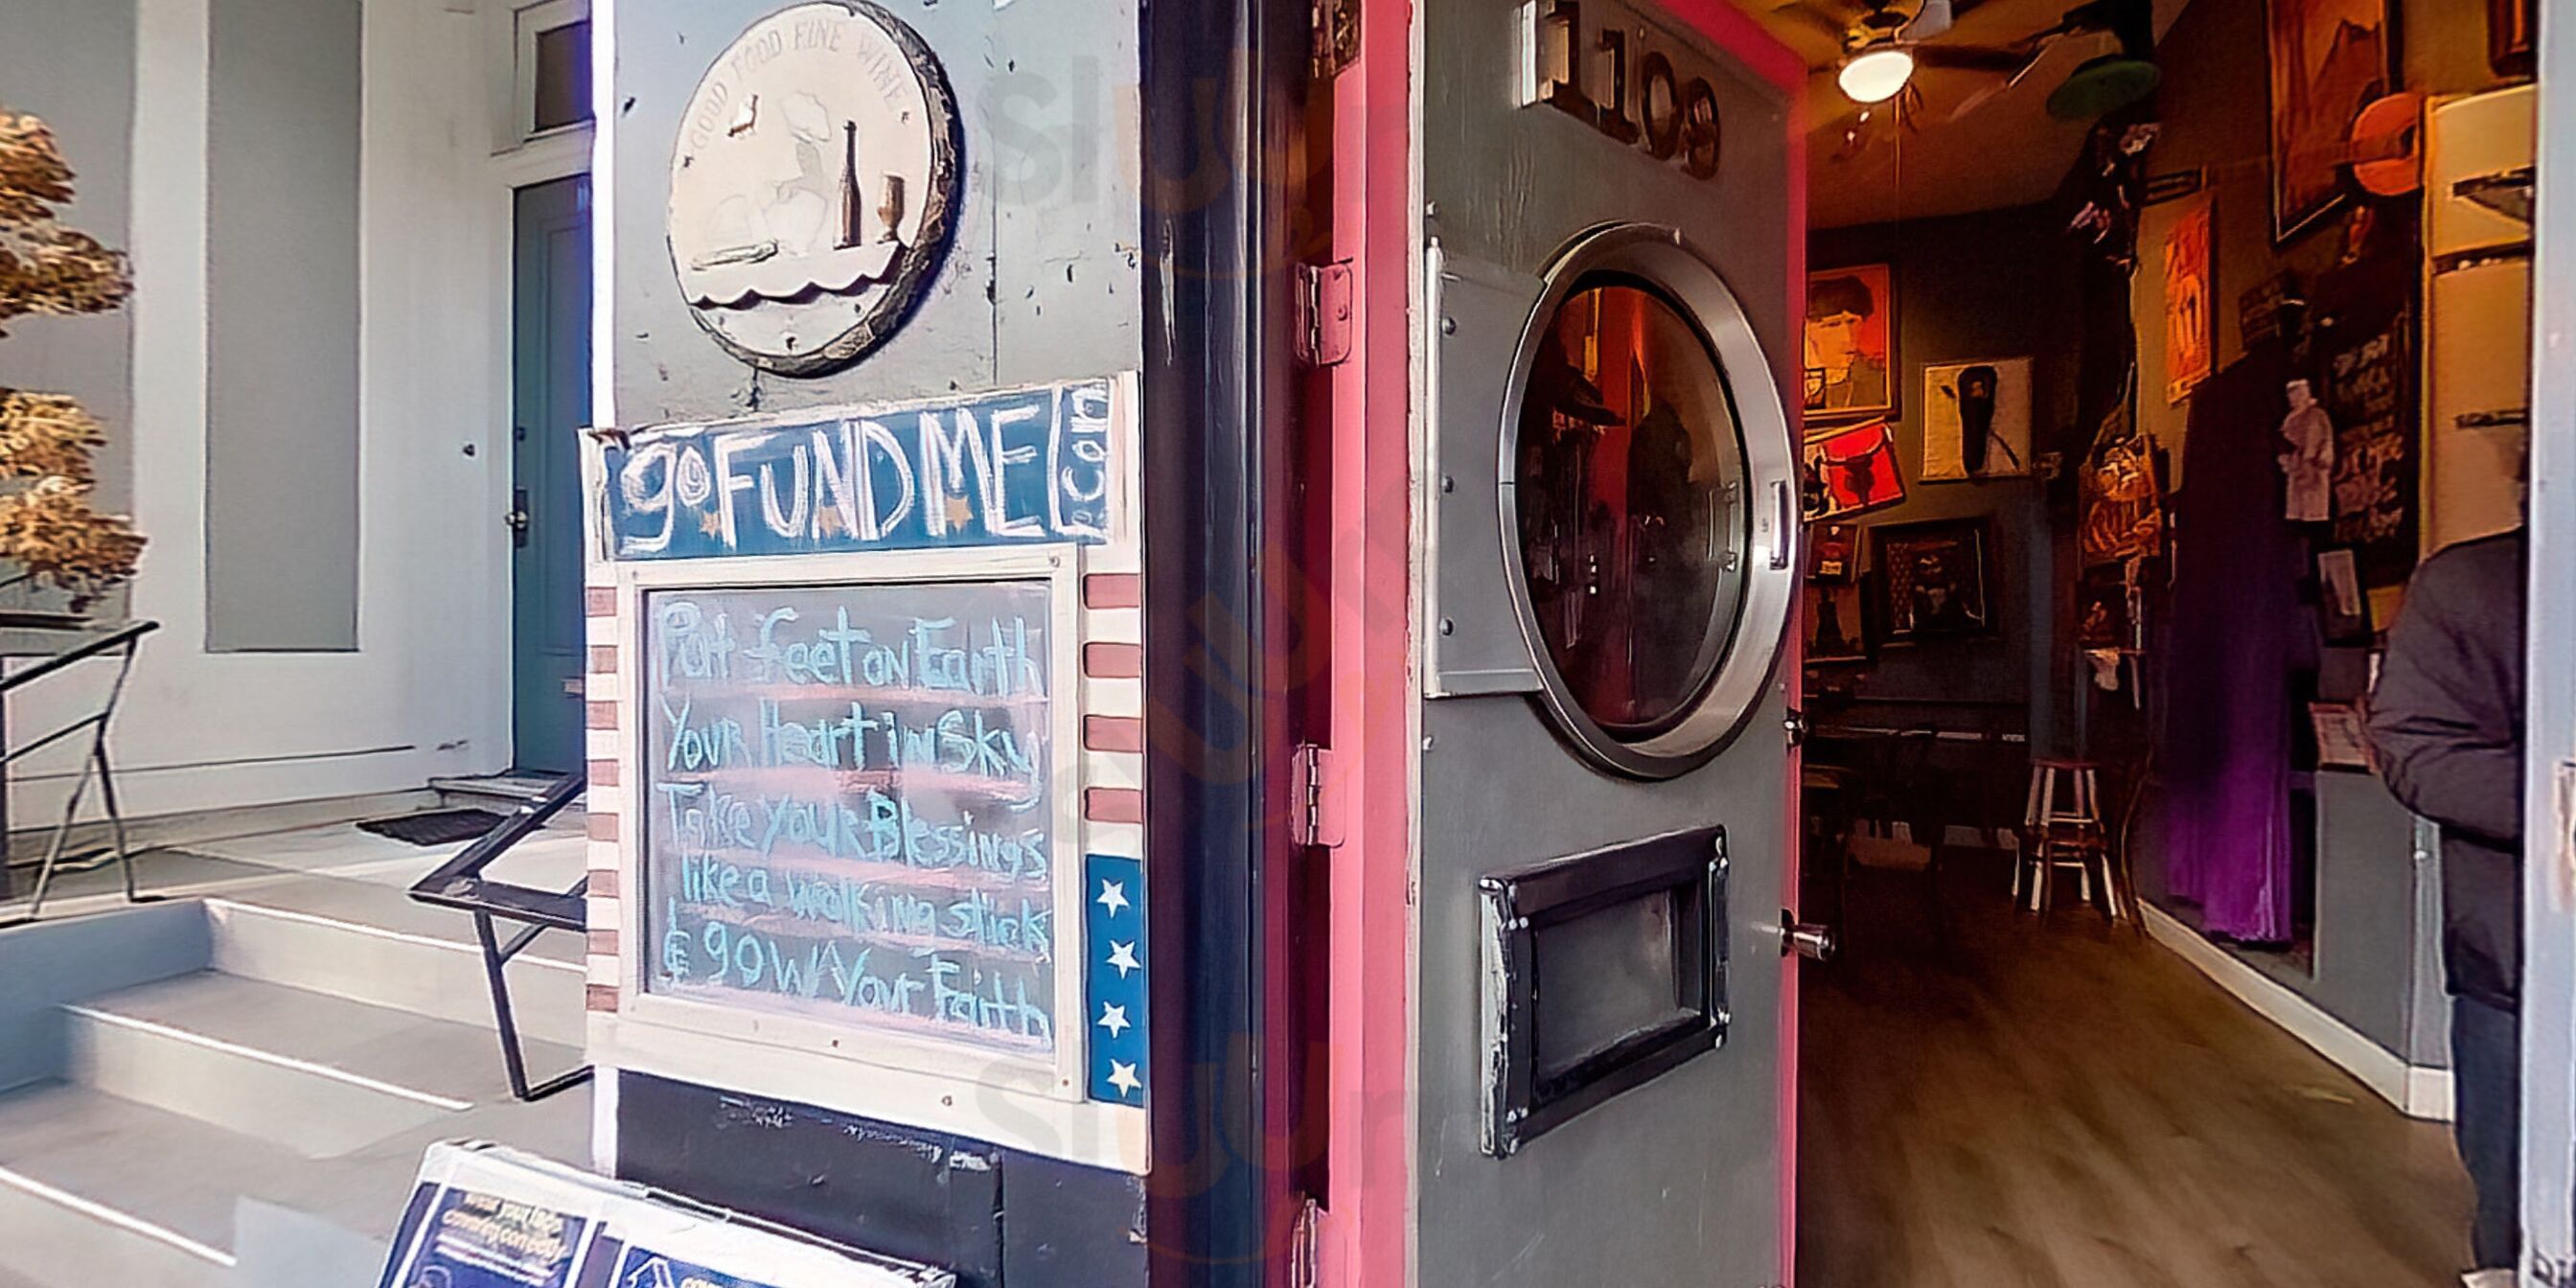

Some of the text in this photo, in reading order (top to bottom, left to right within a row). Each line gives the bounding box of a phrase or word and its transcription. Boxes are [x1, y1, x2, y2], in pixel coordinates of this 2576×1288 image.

[690, 19, 909, 150] GOOD FOOD FINE WINE
[1522, 0, 1722, 181] 1109
[743, 606, 874, 686] feet
[908, 615, 1046, 701] Earth
[759, 696, 879, 771] Heart
[934, 709, 1043, 812] Sky
[656, 782, 757, 849] Take
[680, 851, 745, 907] like
[939, 886, 1052, 961] stick
[924, 954, 1053, 1050] Faith
